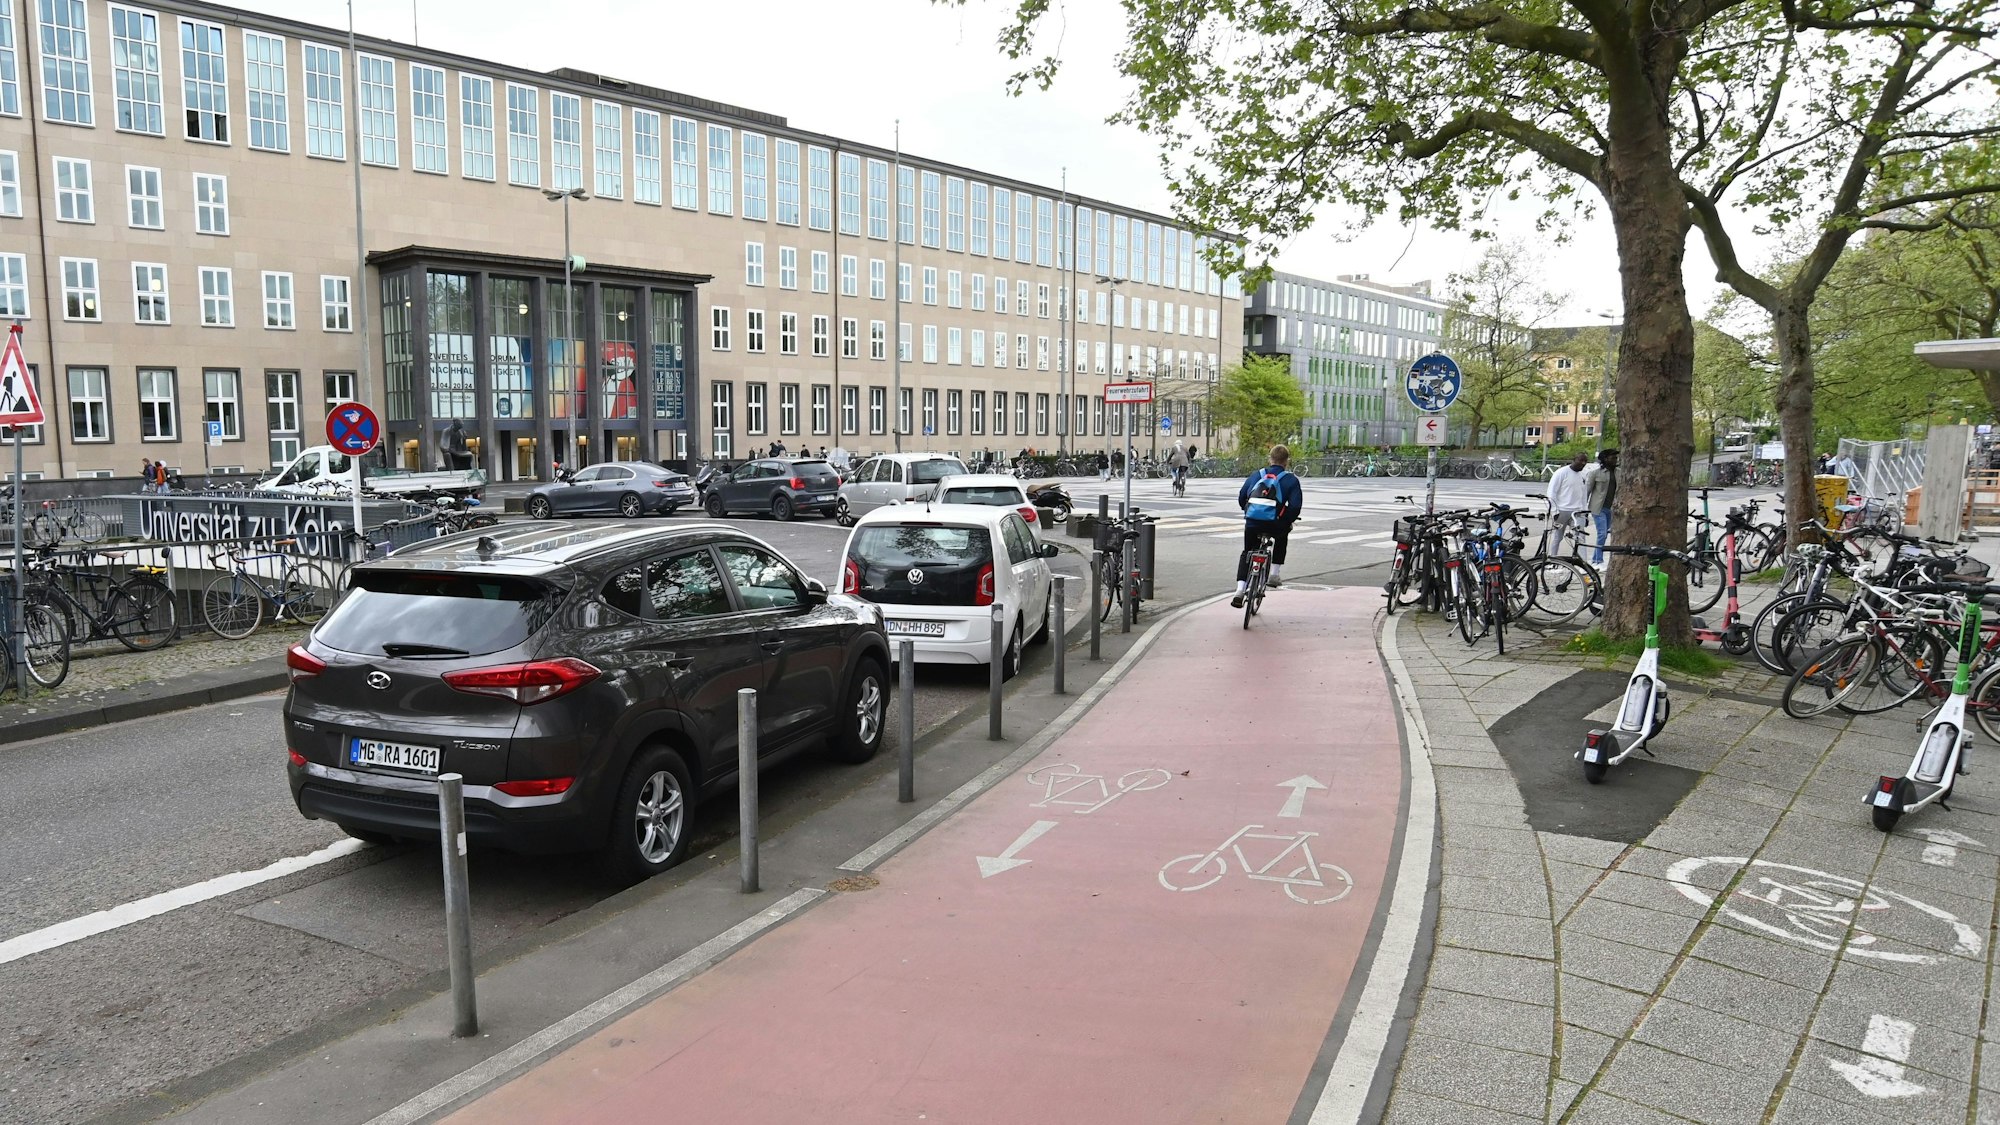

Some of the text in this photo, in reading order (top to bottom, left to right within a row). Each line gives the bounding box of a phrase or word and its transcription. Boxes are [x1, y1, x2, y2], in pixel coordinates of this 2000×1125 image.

[490, 354, 516, 362] ORUM
[1106, 386, 1149, 395] Feuerwehrzufahrt
[211, 423, 219, 436] P
[139, 500, 343, 558] Universität zu Köln
[888, 621, 944, 634] DN HH 895
[358, 741, 437, 769] MG RA 1601
